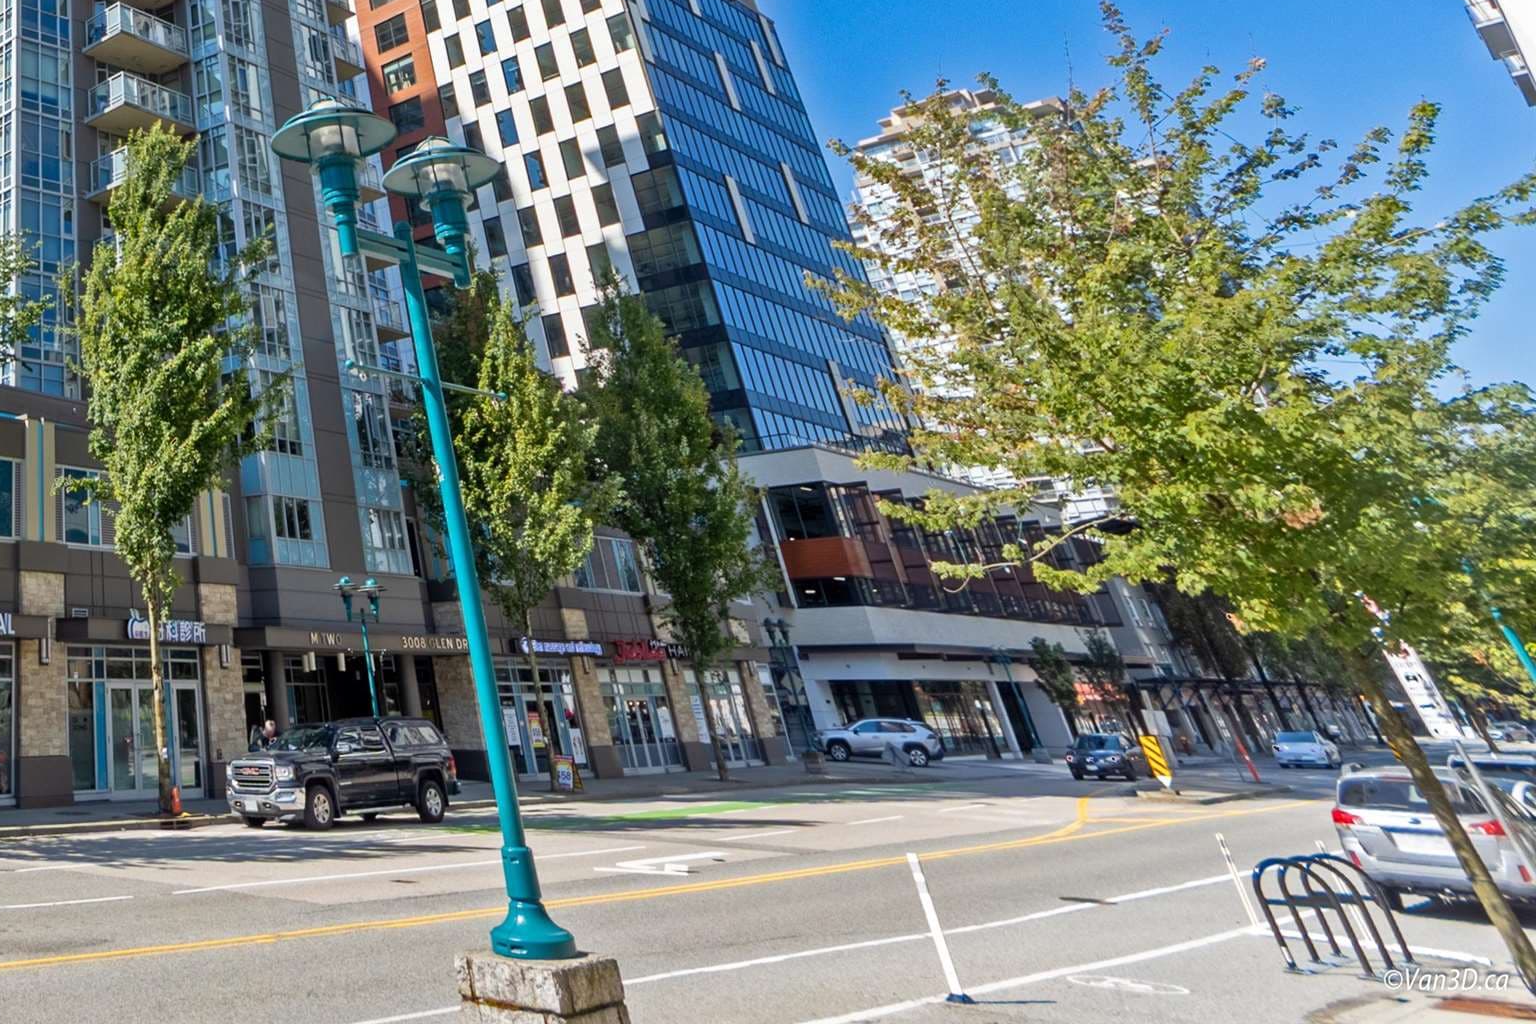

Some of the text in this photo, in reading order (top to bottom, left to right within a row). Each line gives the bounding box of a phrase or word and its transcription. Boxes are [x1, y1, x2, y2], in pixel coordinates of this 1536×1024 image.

[310, 631, 343, 646] M TWO
[402, 636, 468, 650] 3008 GLEN DR
